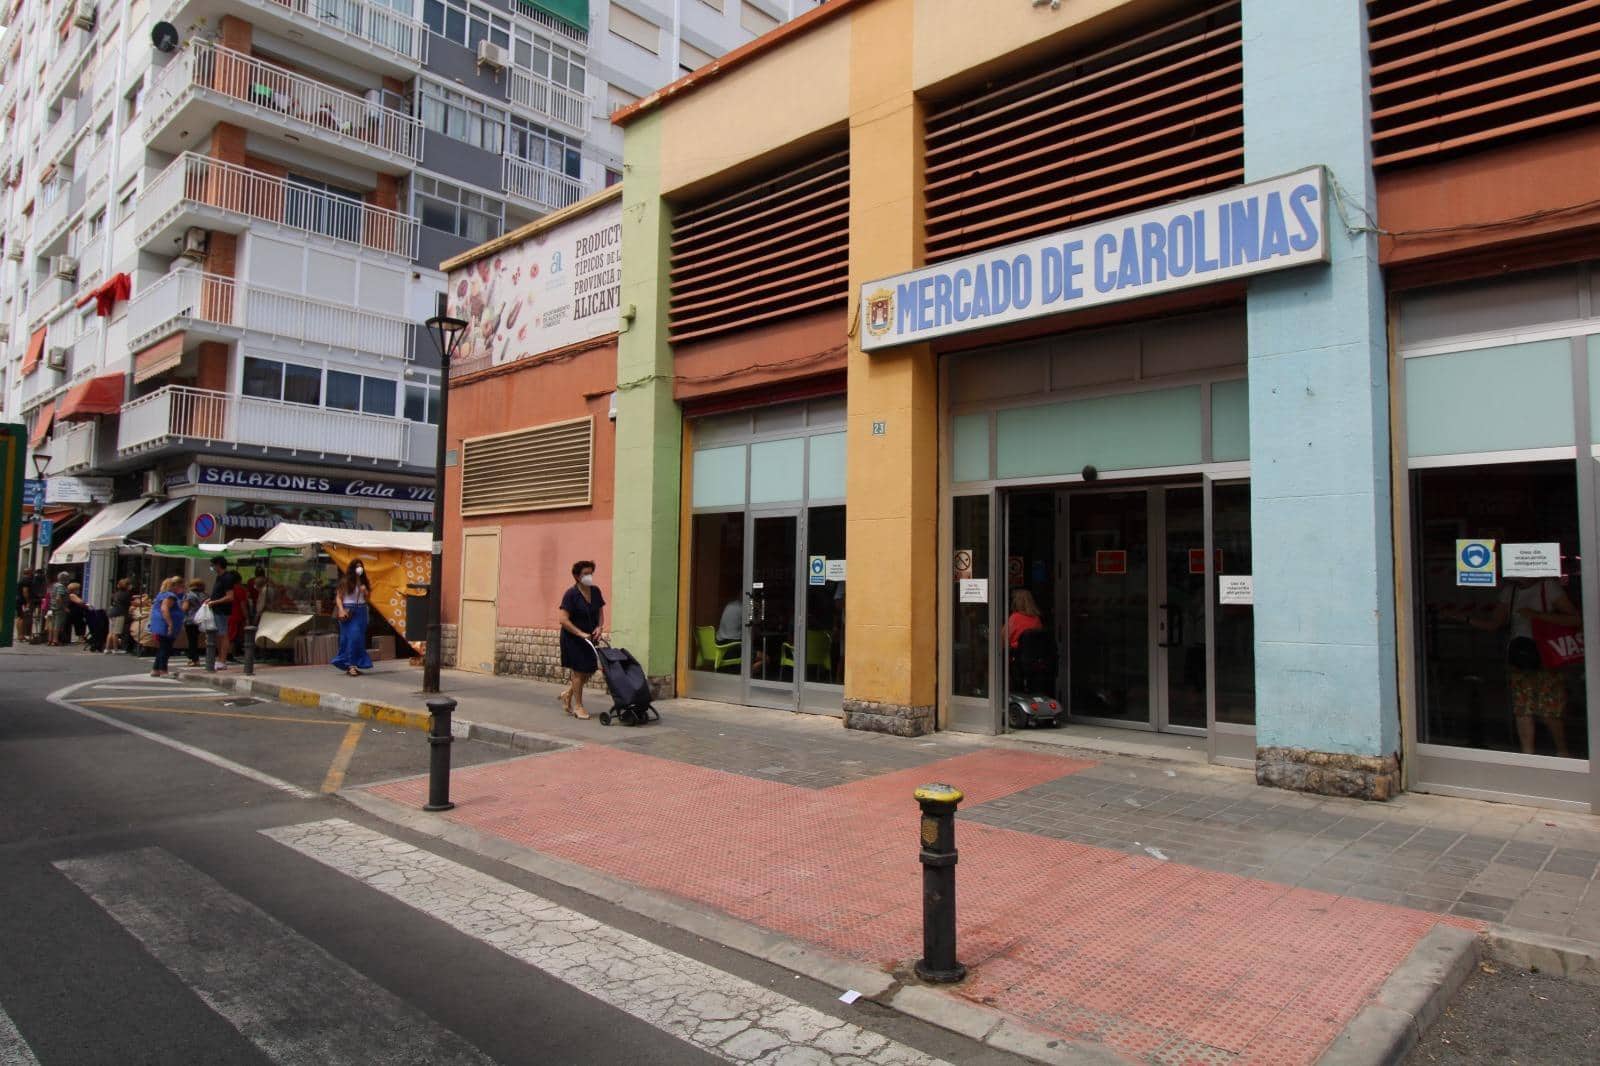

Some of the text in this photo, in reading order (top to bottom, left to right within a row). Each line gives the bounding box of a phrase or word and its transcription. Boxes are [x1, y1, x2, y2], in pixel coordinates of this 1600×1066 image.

[574, 253, 604, 277] TÍPICOS
[897, 183, 1319, 334] MERCADO DE CAROLINAS
[574, 268, 615, 296] PROVINCIA
[206, 468, 329, 491] SALAZONES
[345, 479, 396, 498] Cala
